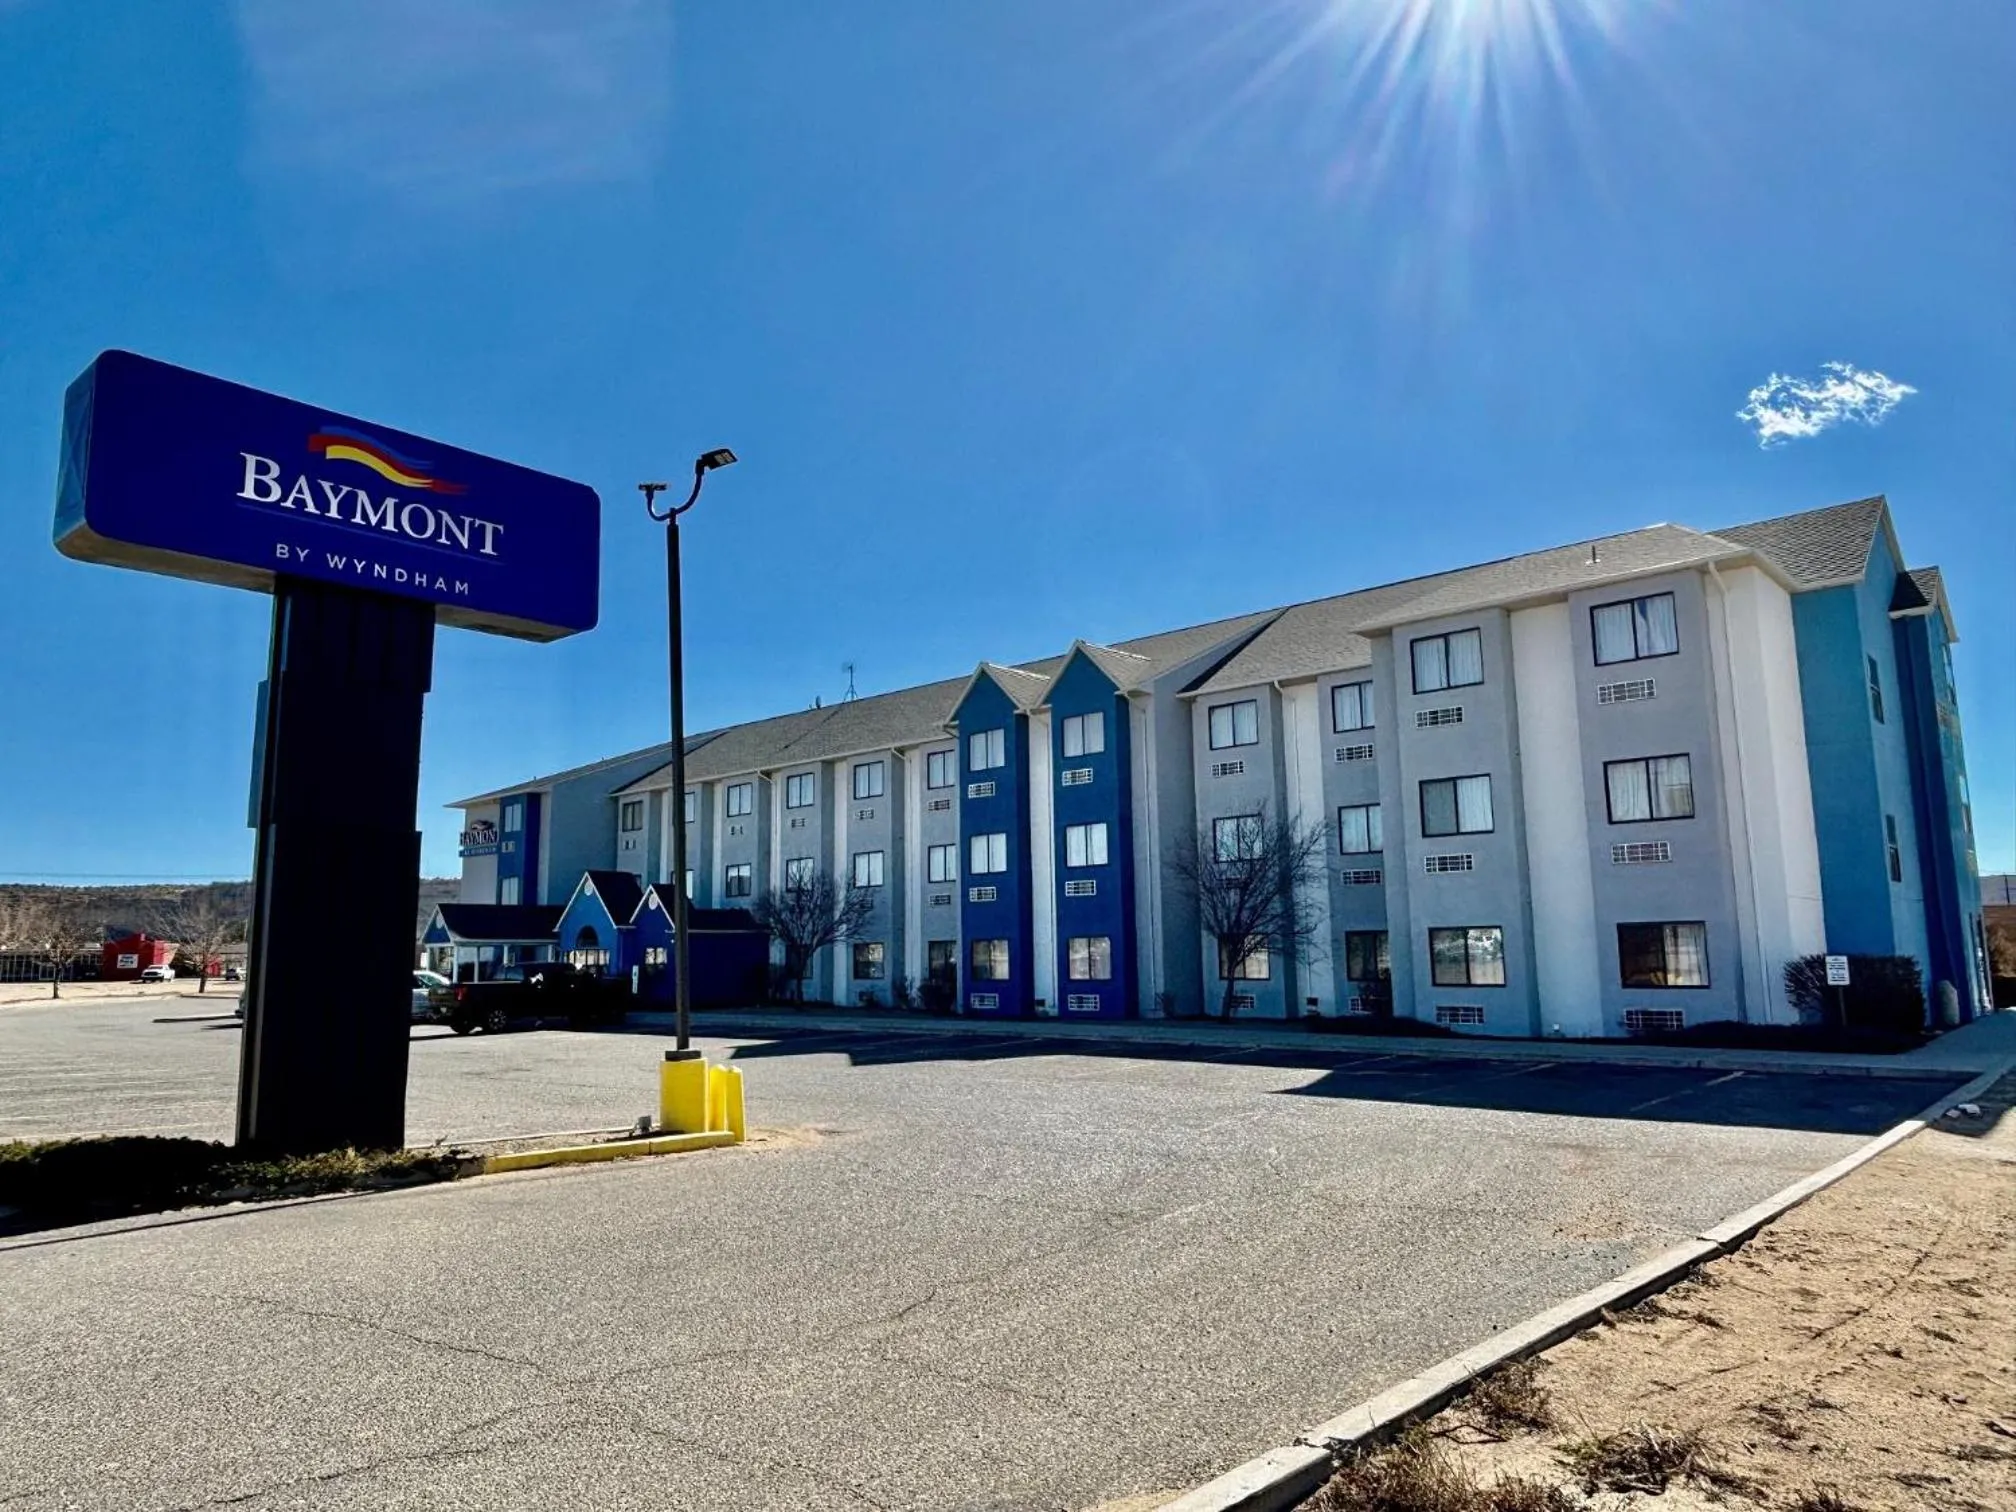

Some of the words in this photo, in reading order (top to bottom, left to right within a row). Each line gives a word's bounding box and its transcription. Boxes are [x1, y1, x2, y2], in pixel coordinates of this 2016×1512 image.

[236, 452, 504, 556] BAYMONT
[275, 543, 310, 562] BY
[326, 552, 469, 596] WYNDHAM
